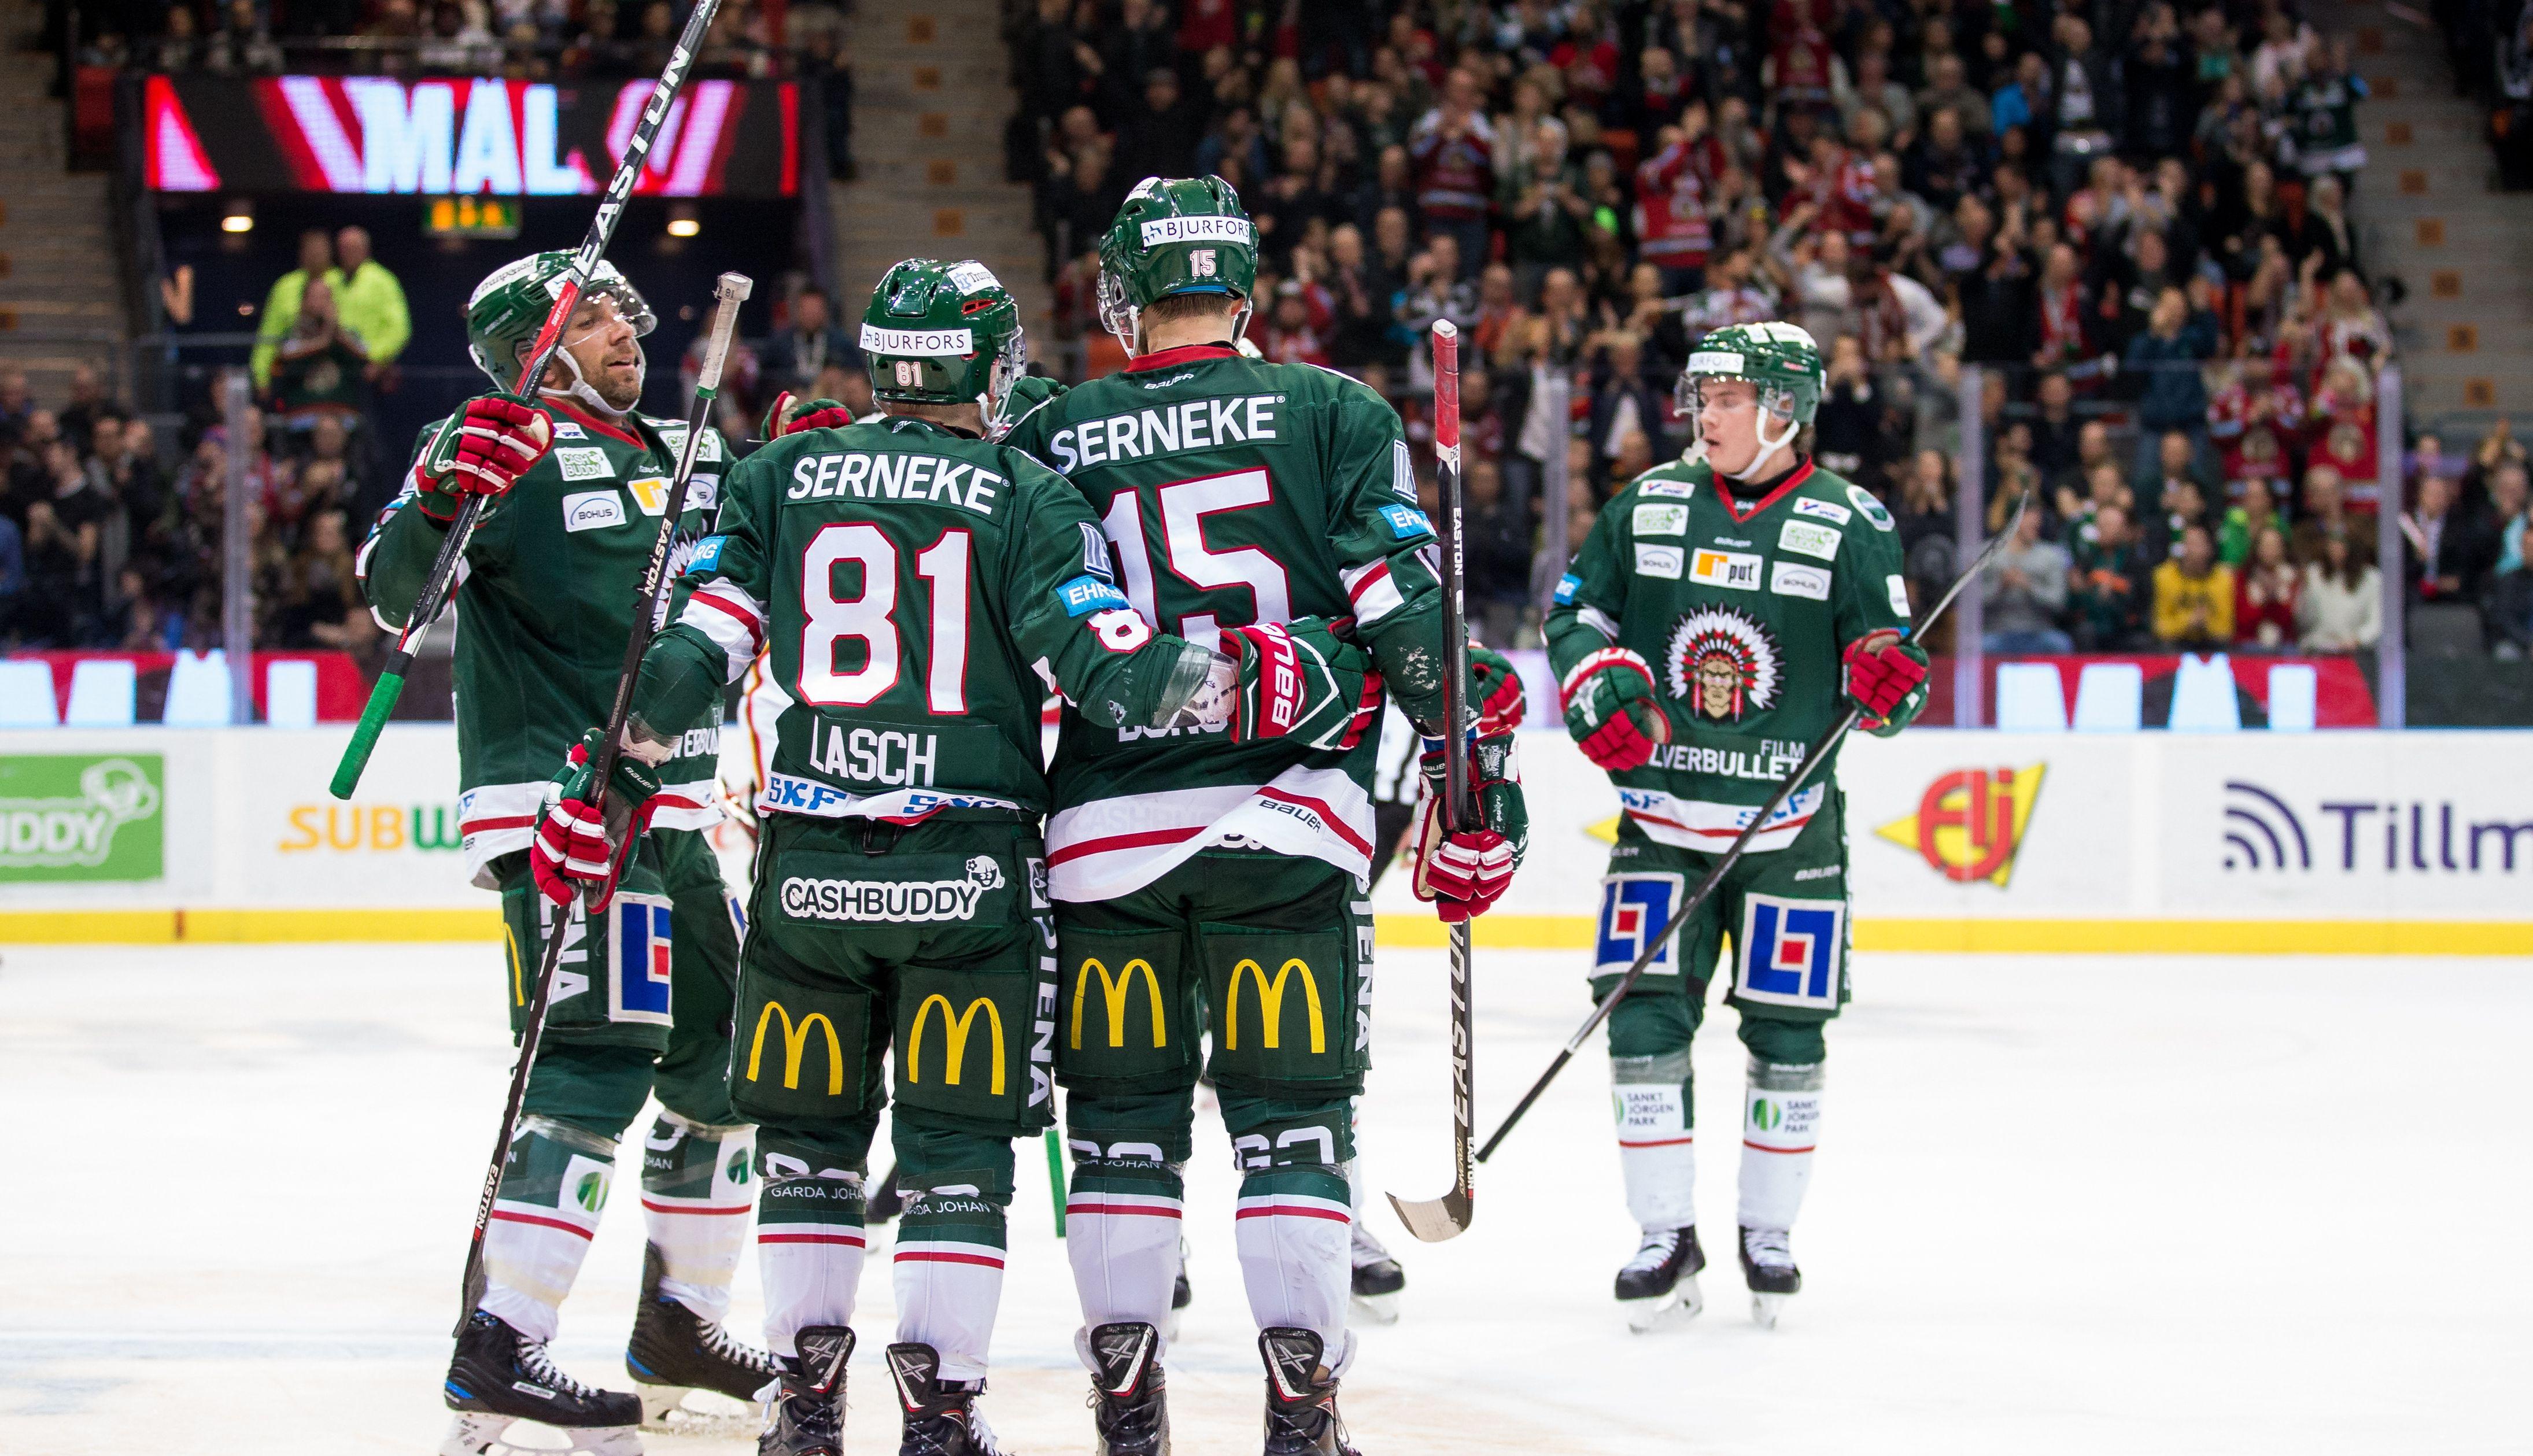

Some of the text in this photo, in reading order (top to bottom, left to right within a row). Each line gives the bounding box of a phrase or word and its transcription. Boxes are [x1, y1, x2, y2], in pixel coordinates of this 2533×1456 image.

[1167, 220, 1249, 239] BJURFORS
[1189, 249, 1216, 277] 15
[874, 332, 965, 352] BJURFORS
[895, 360, 924, 387] 81
[578, 508, 613, 520] BOHUS
[1453, 507, 1464, 576] EASTON
[644, 518, 673, 597] EASTON
[1101, 466, 1293, 655] 15
[797, 521, 973, 716] 81
[810, 715, 937, 787] LASCH
[1760, 740, 1806, 759] FILM
[624, 767, 655, 790] BAUER
[767, 777, 847, 811] SKF
[1258, 799, 1321, 834] BAUER
[0, 810, 106, 853] DDY
[786, 882, 977, 918] CASHBUDDY
[1626, 1092, 1664, 1102] SANKT
[1628, 1102, 1675, 1115] JÖRGEN
[1628, 1116, 1657, 1126] PARK
[476, 1163, 499, 1230] EASTON
[771, 1185, 826, 1199] GÅRDA
[936, 1200, 991, 1213] JOHAN
